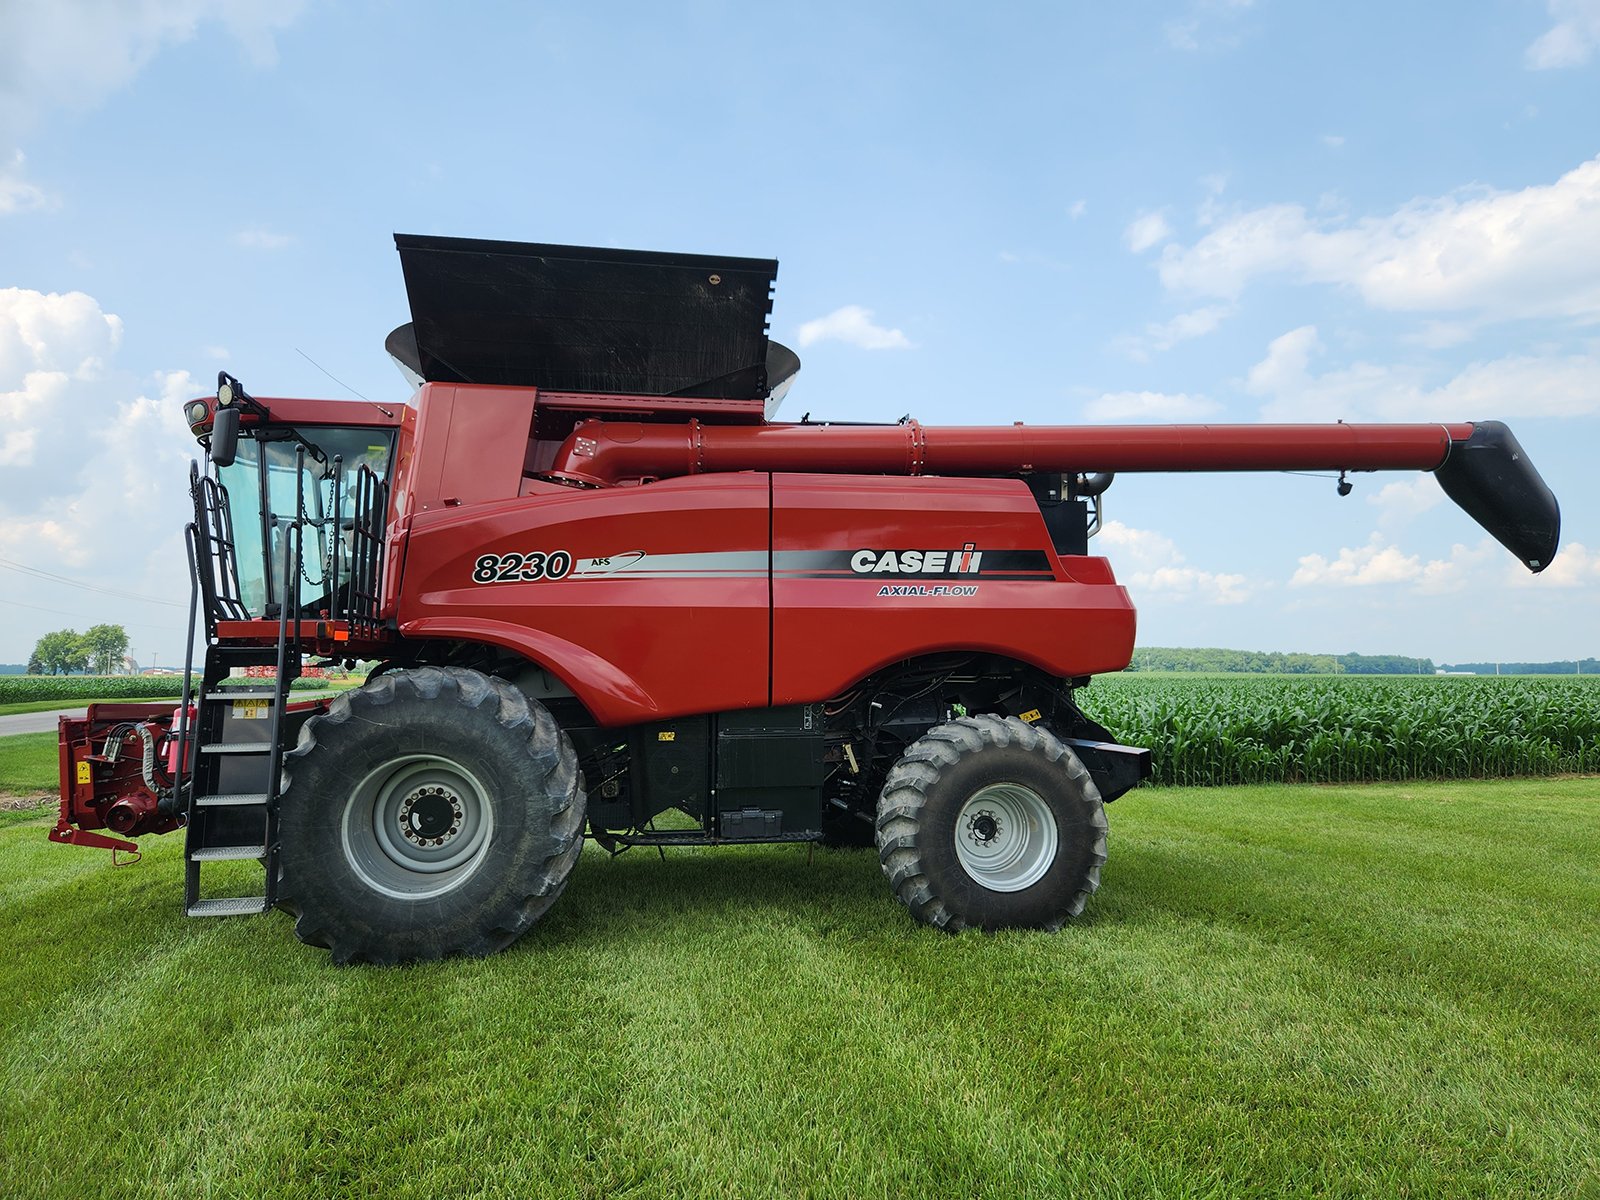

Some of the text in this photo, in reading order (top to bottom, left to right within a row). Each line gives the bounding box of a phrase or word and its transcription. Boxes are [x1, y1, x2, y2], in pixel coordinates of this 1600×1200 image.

[472, 550, 571, 583] 8230
[591, 557, 611, 567] AFS
[851, 551, 948, 573] CASE
[878, 585, 978, 597] AXIAL-FLOW
